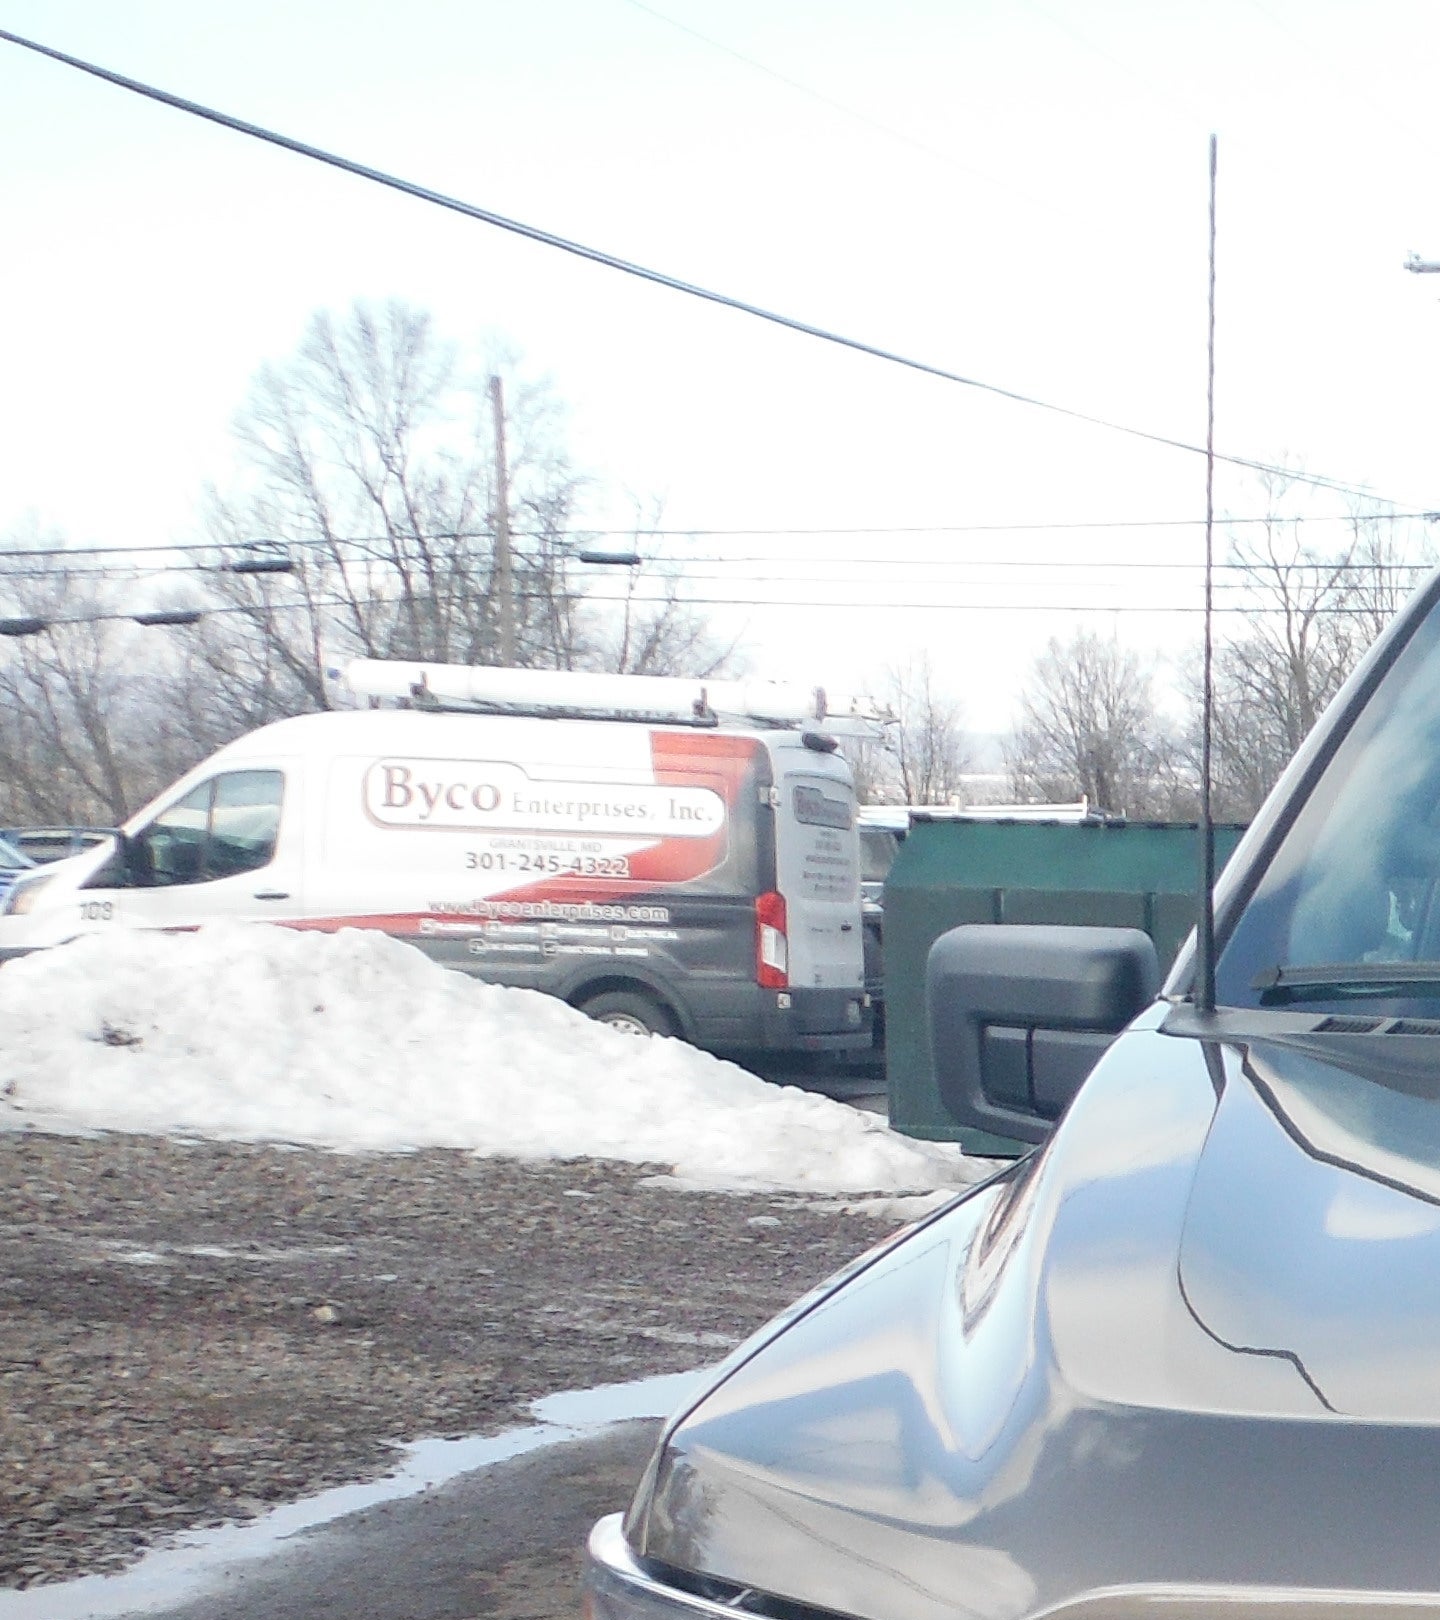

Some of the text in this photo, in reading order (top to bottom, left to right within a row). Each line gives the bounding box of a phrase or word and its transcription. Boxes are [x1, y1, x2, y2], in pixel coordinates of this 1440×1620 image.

[381, 765, 501, 820] Byco
[667, 797, 714, 822] Inc.
[465, 851, 629, 876] 301-245-4322
